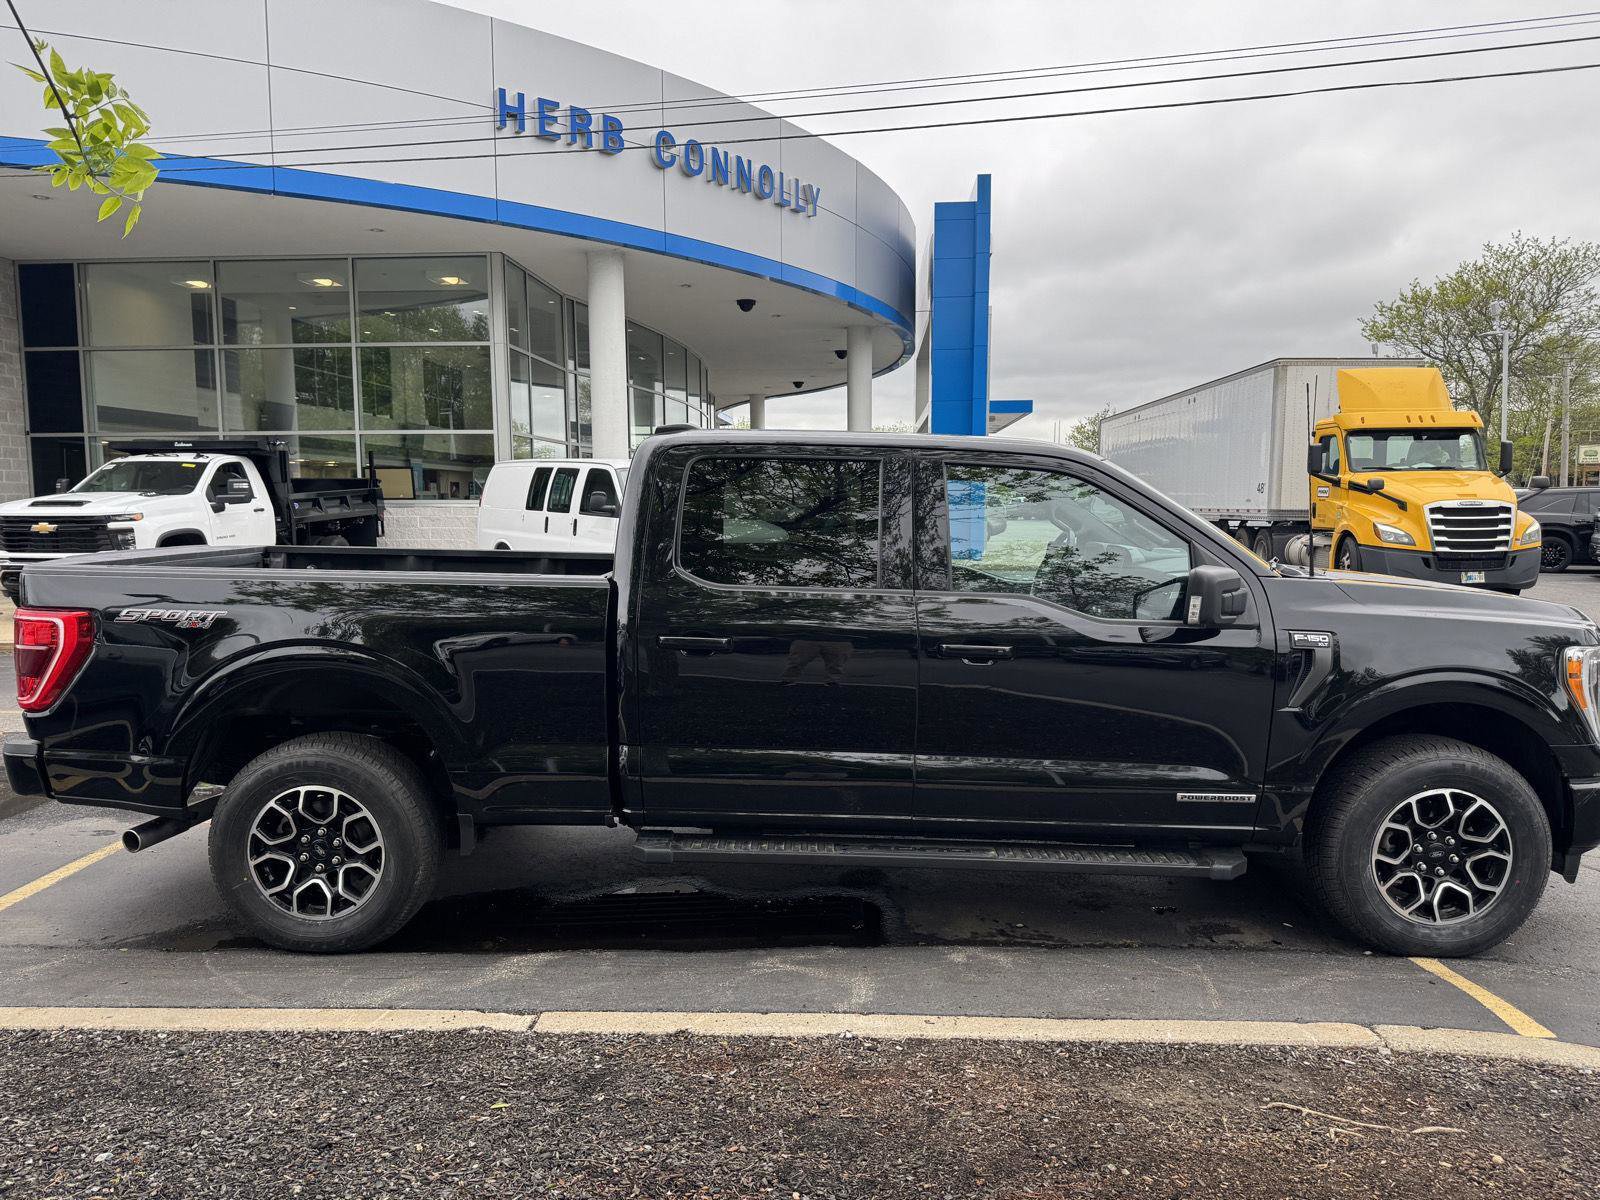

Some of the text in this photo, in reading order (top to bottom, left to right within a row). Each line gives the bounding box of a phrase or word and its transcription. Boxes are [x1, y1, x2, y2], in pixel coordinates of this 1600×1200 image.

[496, 87, 821, 217] HERB CONNOLLY
[114, 608, 227, 623] SPORT
[1293, 634, 1329, 642] F-150
